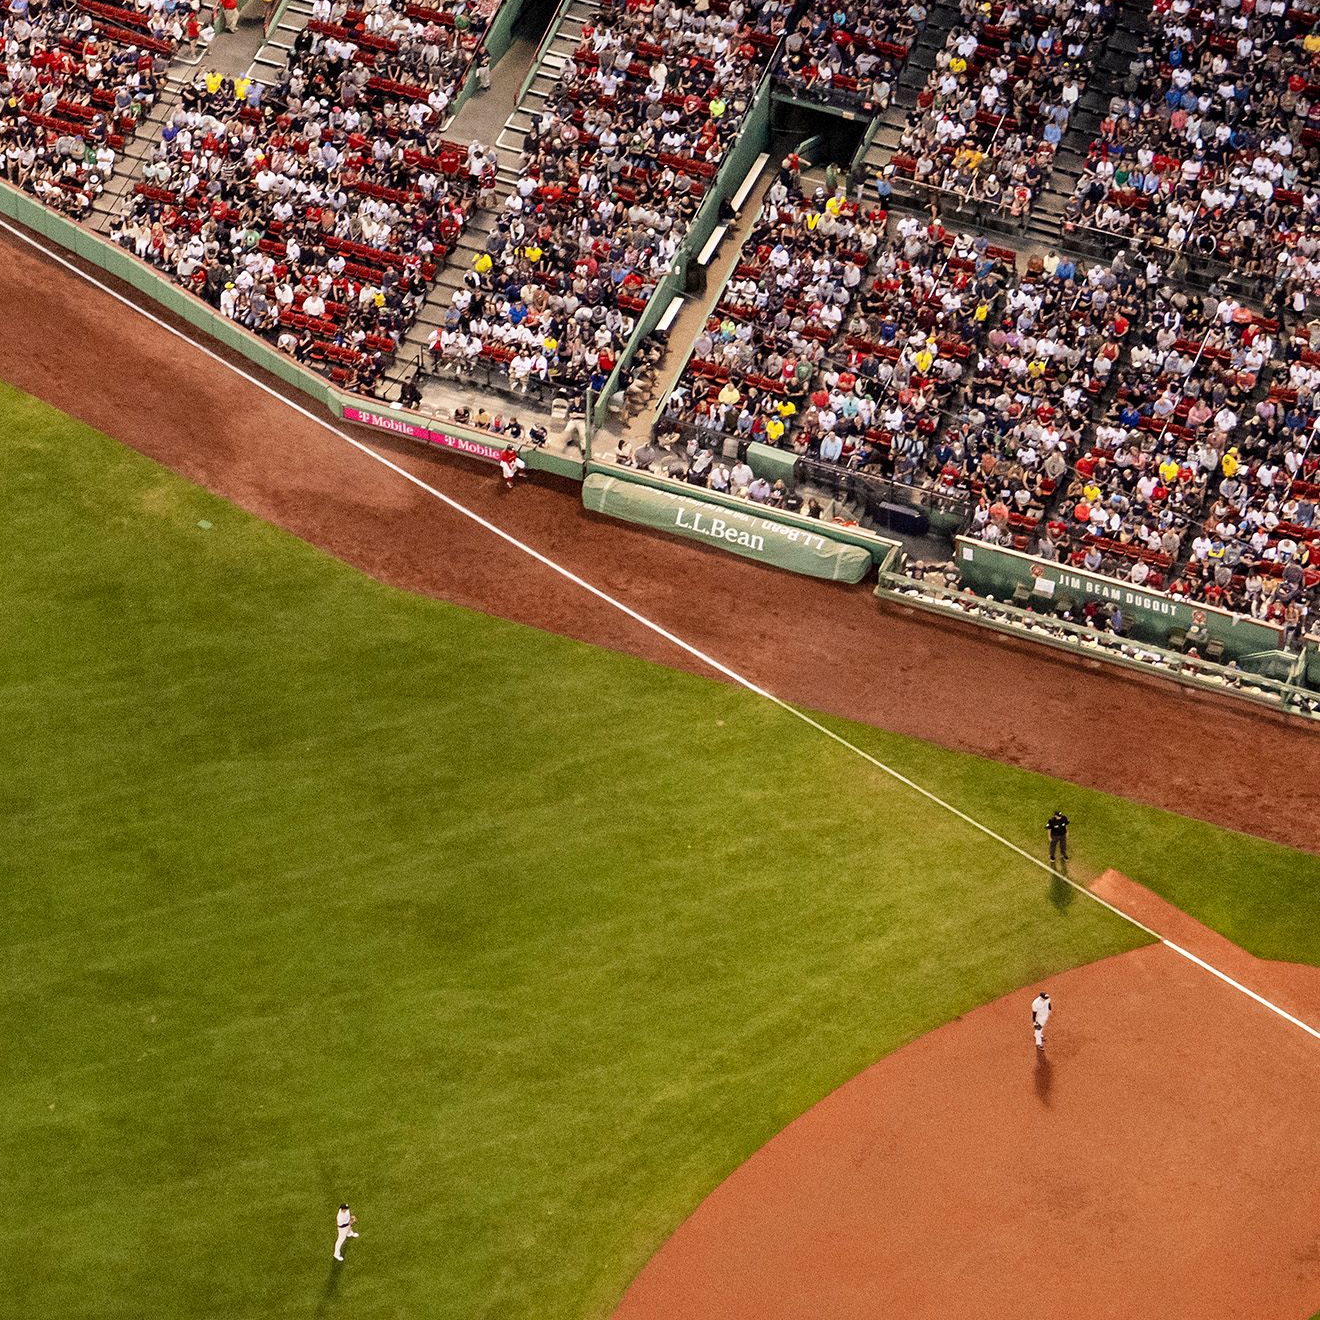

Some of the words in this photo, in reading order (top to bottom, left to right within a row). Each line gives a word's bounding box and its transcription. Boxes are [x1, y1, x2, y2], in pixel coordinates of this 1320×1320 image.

[371, 416, 413, 435] Mobile
[458, 439, 500, 460] Mobile
[675, 509, 764, 551] L.L.Bean
[1059, 575, 1080, 589] JIM
[1086, 582, 1120, 600] BEAM
[1126, 594, 1177, 616] DUGOUT
